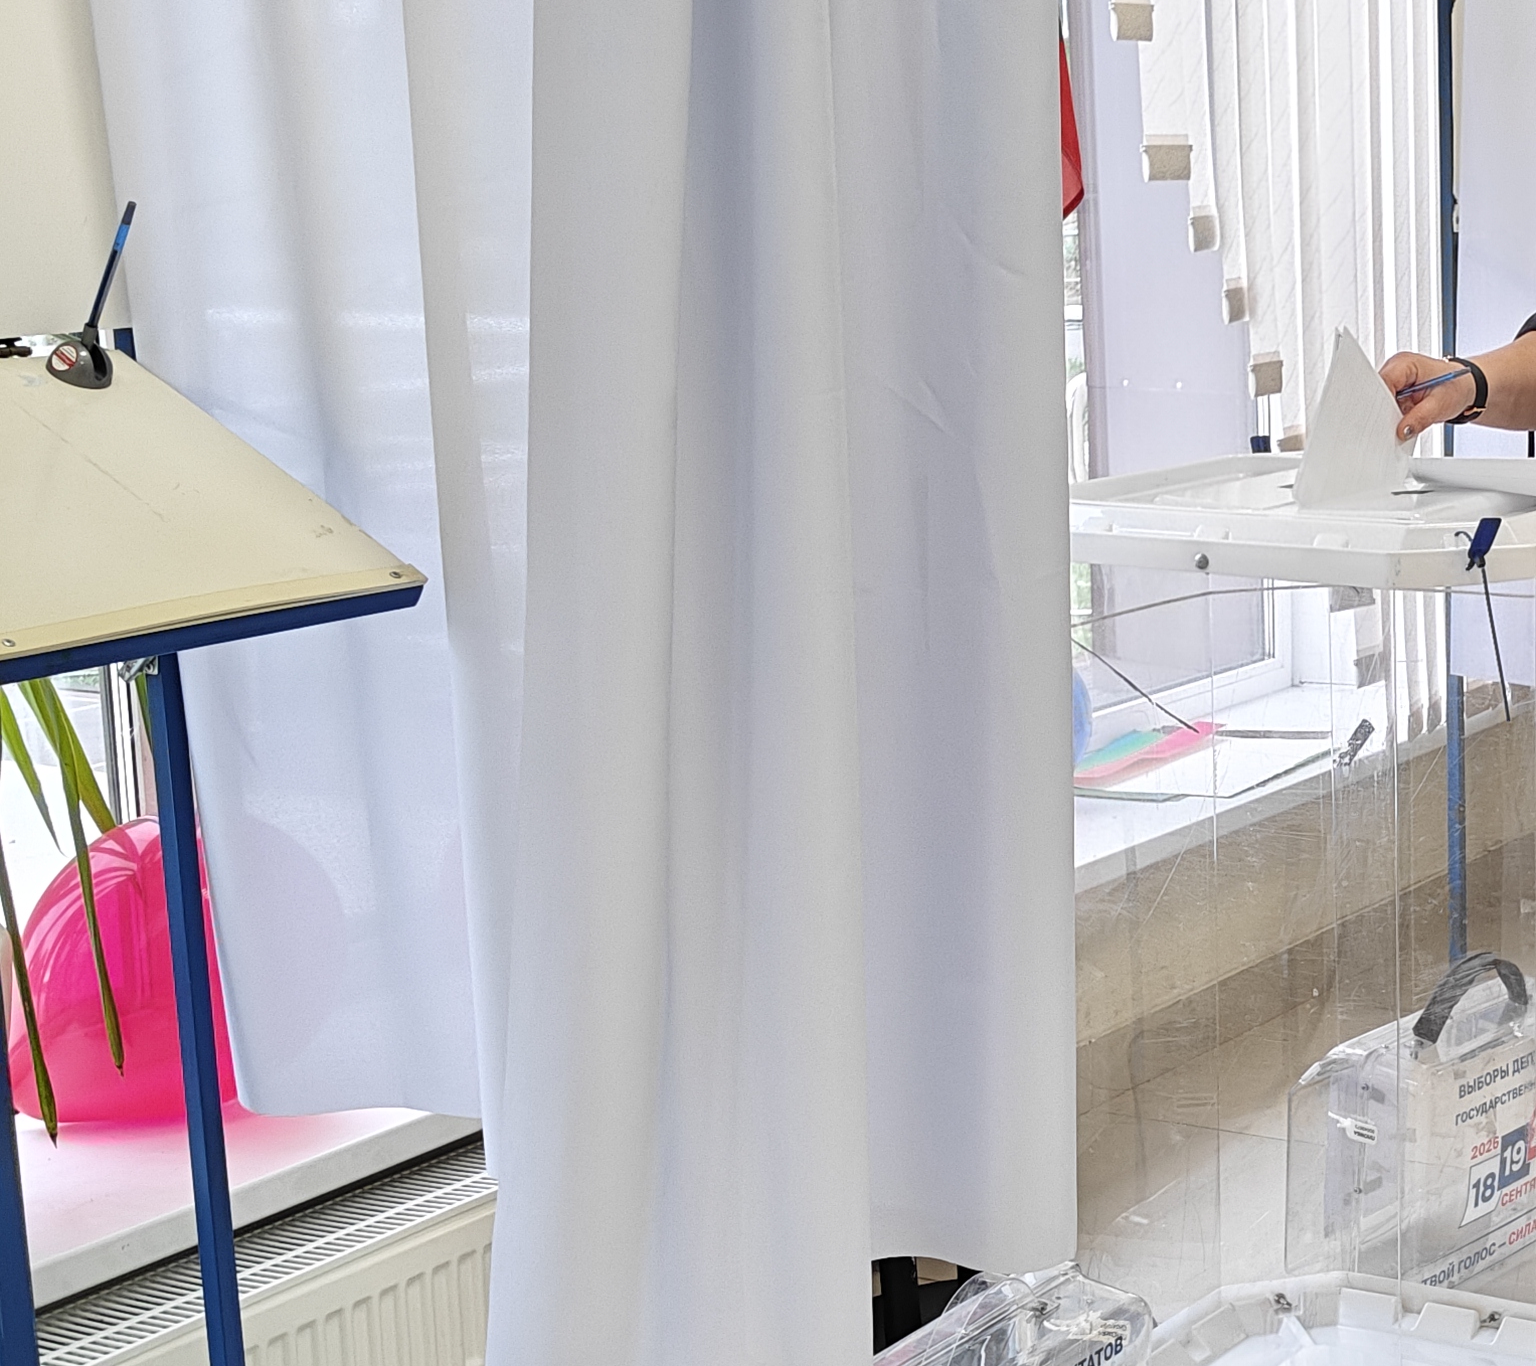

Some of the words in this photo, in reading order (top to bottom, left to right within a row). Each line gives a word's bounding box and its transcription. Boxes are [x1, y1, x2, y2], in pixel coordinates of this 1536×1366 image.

[1458, 1063, 1509, 1099] ВЫБОРЫ
[1470, 1136, 1499, 1160] 2026
[1472, 1171, 1496, 1208] 18
[1503, 1140, 1526, 1176] 19
[1457, 1242, 1496, 1274] ГОЛОС
[1508, 1218, 1536, 1245] СИЛА
